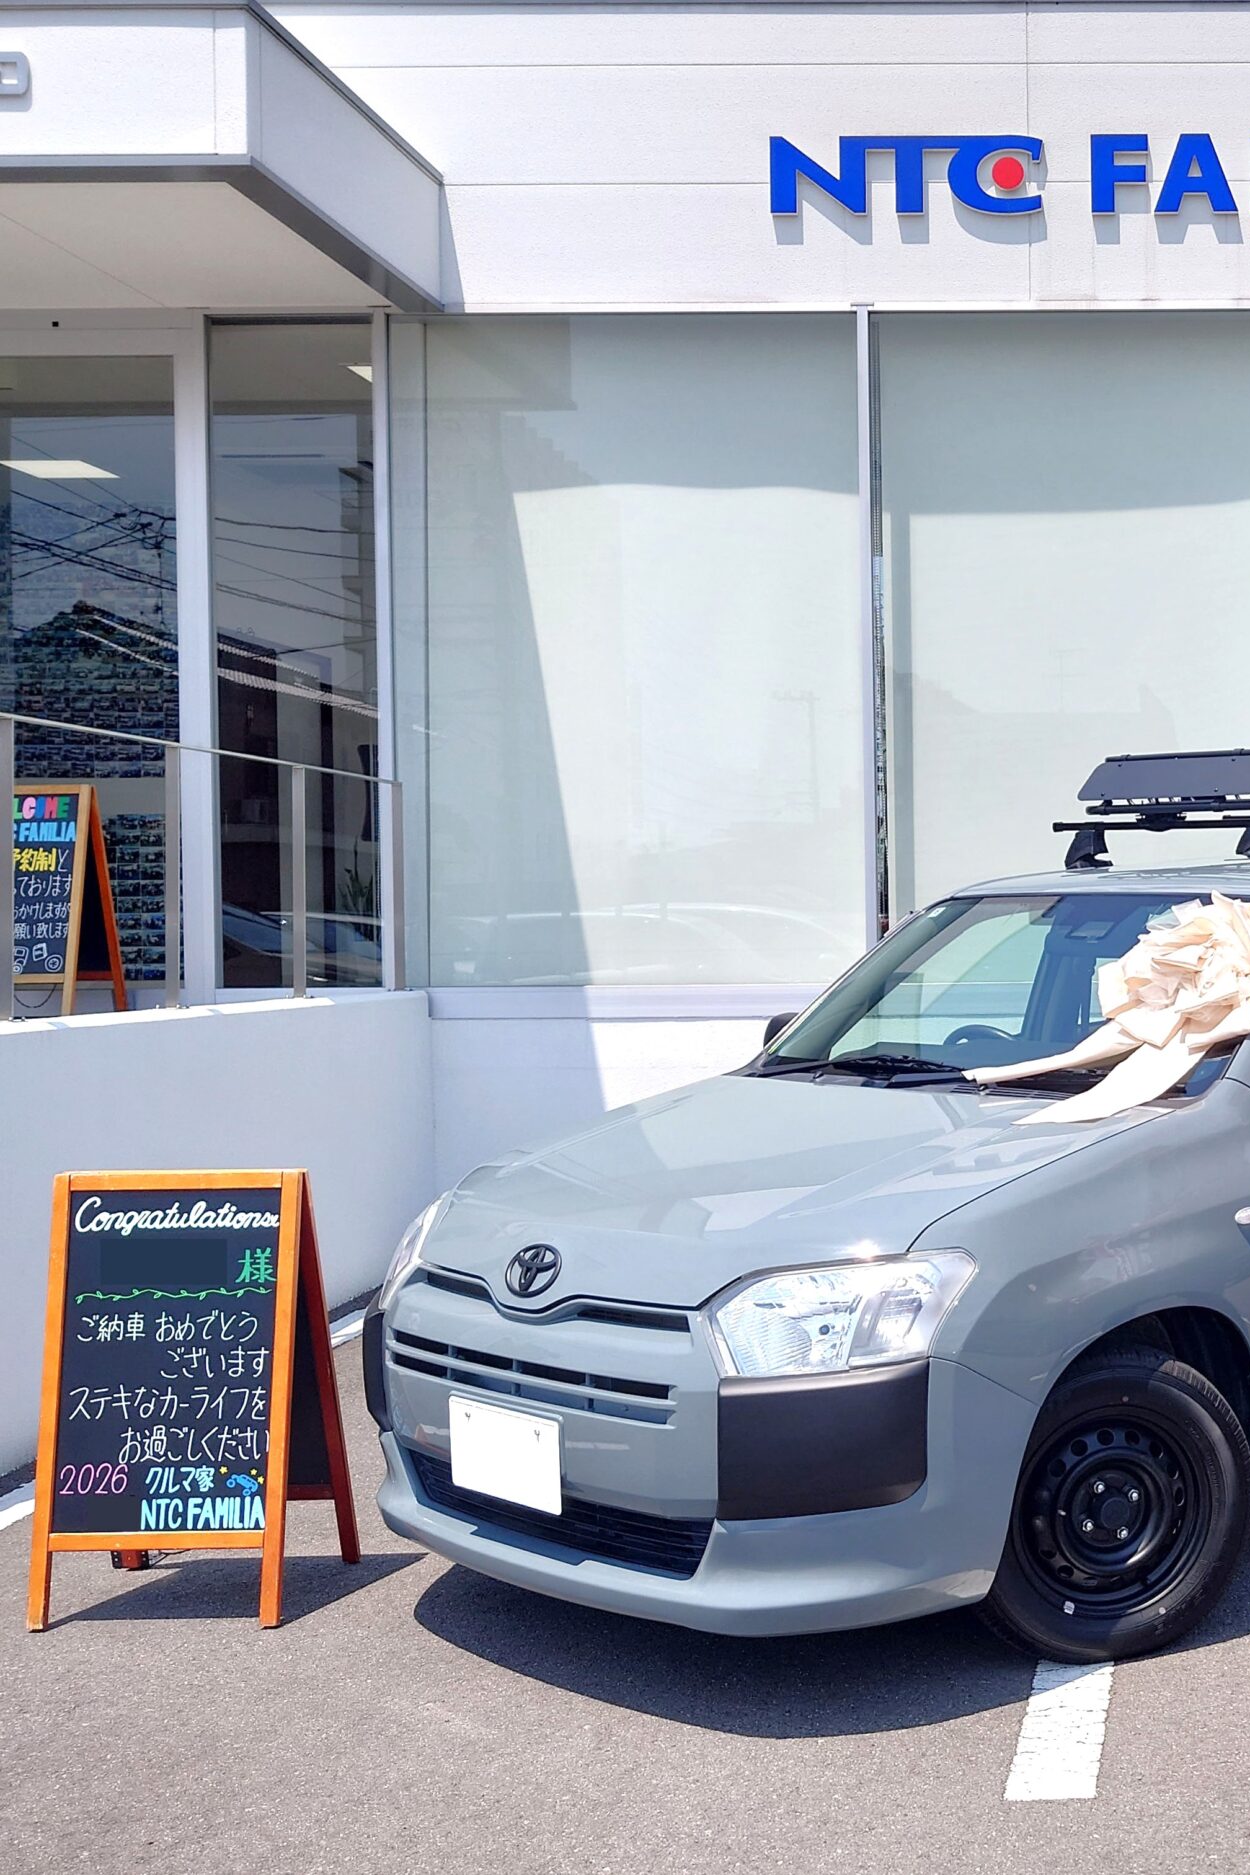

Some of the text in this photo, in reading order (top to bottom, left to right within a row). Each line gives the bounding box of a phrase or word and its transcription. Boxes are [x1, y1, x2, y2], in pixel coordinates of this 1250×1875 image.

[769, 134, 1045, 215] NTC
[13, 796, 70, 819] LCOME
[19, 821, 76, 842] FAMILIA
[235, 1247, 277, 1283] 様
[76, 1310, 258, 1342] ご納車 おめでとう
[160, 1345, 270, 1378] ございます
[68, 1384, 268, 1420] ステキなカーライフを
[118, 1424, 270, 1464] お過ごしください
[59, 1463, 129, 1495] 2026
[145, 1464, 216, 1494] クルマ家
[140, 1495, 265, 1530] NTC FAMILIA
